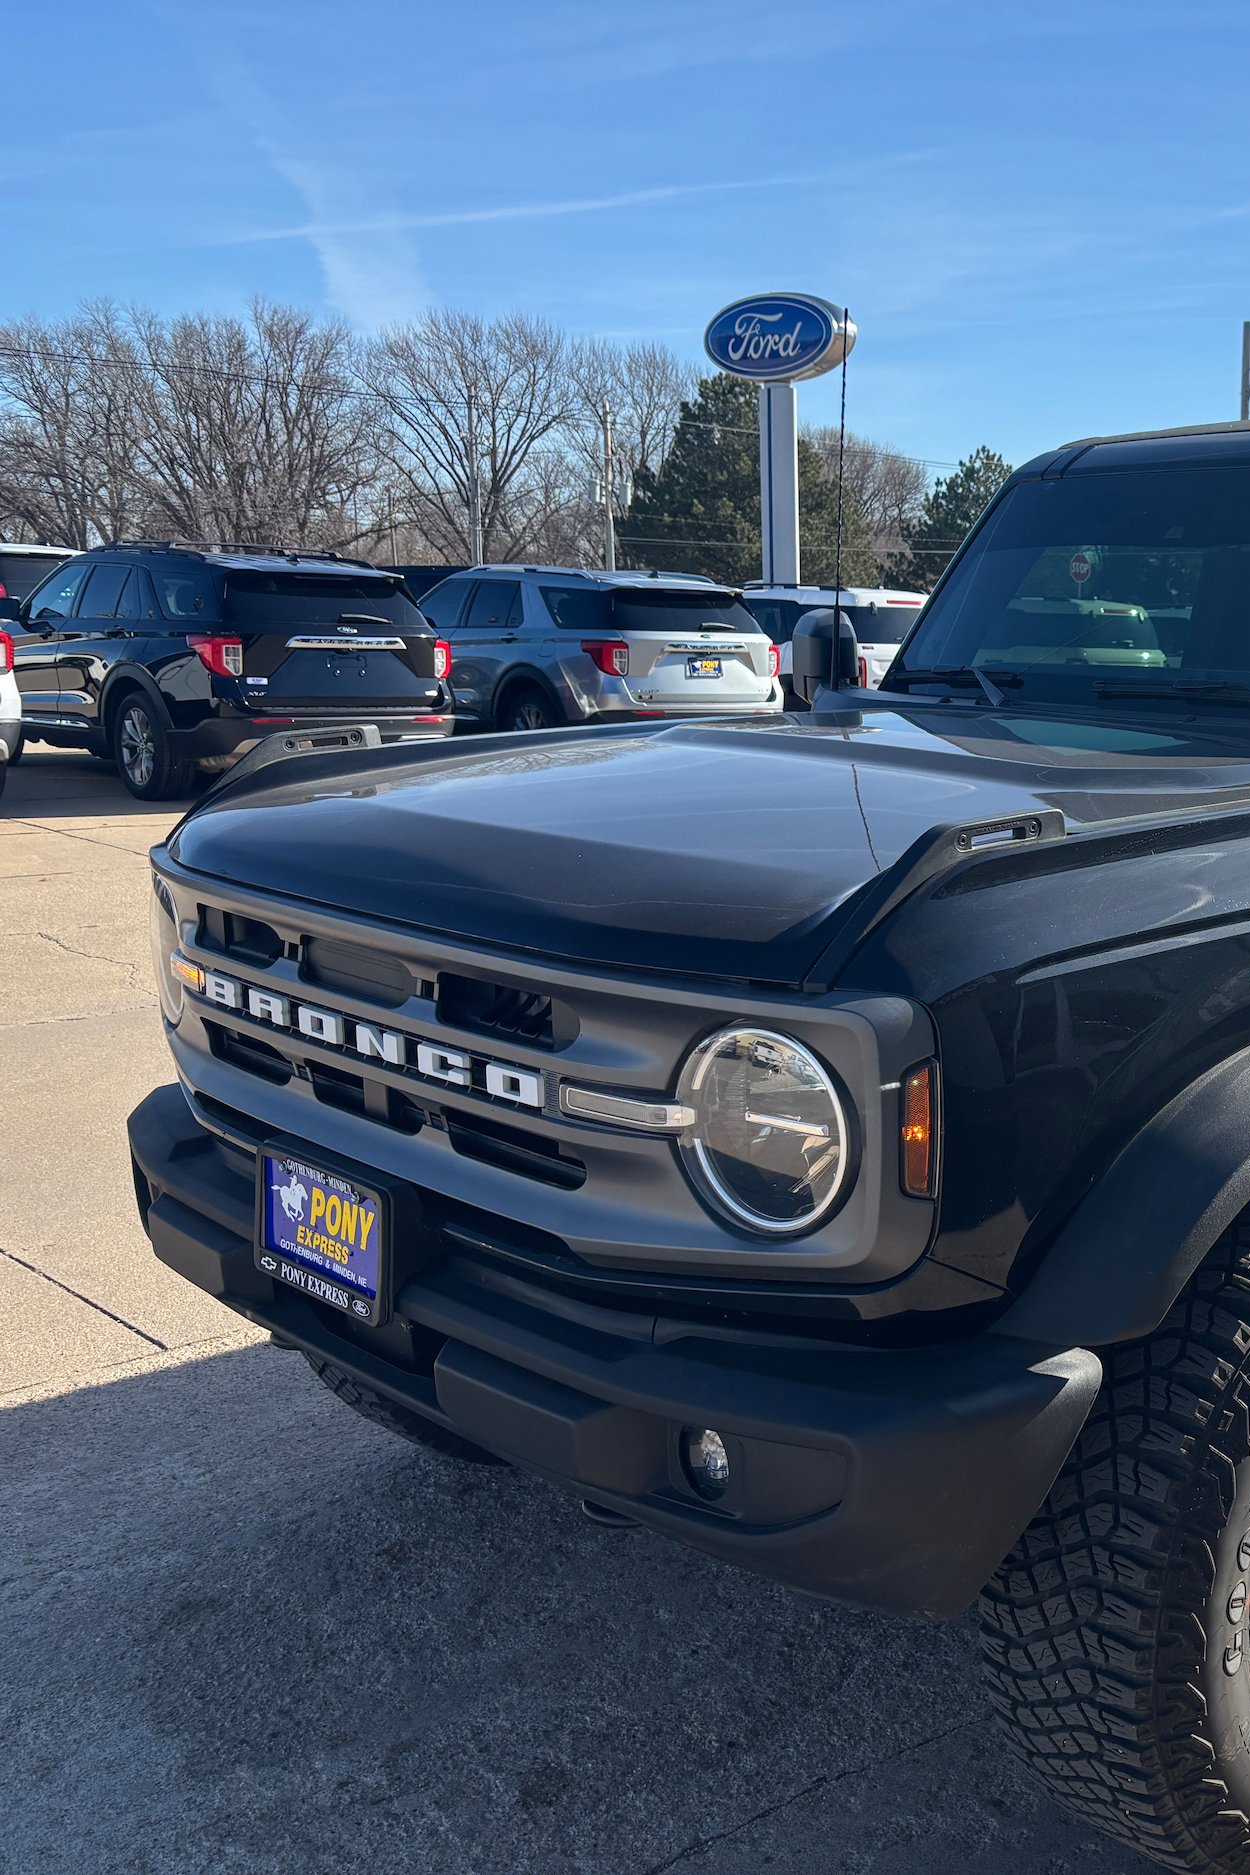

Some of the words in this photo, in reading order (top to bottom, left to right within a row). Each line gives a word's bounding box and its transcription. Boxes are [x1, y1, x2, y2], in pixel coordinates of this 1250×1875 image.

[728, 312, 802, 361] Ford
[1071, 562, 1090, 574] STOP
[205, 971, 546, 1108] BRONCO
[310, 1186, 375, 1251] PONY
[280, 1238, 323, 1266] GOTHENBURG
[325, 1259, 331, 1270] &
[332, 1262, 357, 1284] MINDEN,
[296, 1225, 349, 1265] EXPRESS
[281, 1262, 307, 1288] PONY
[307, 1274, 349, 1309] EXPRESS
